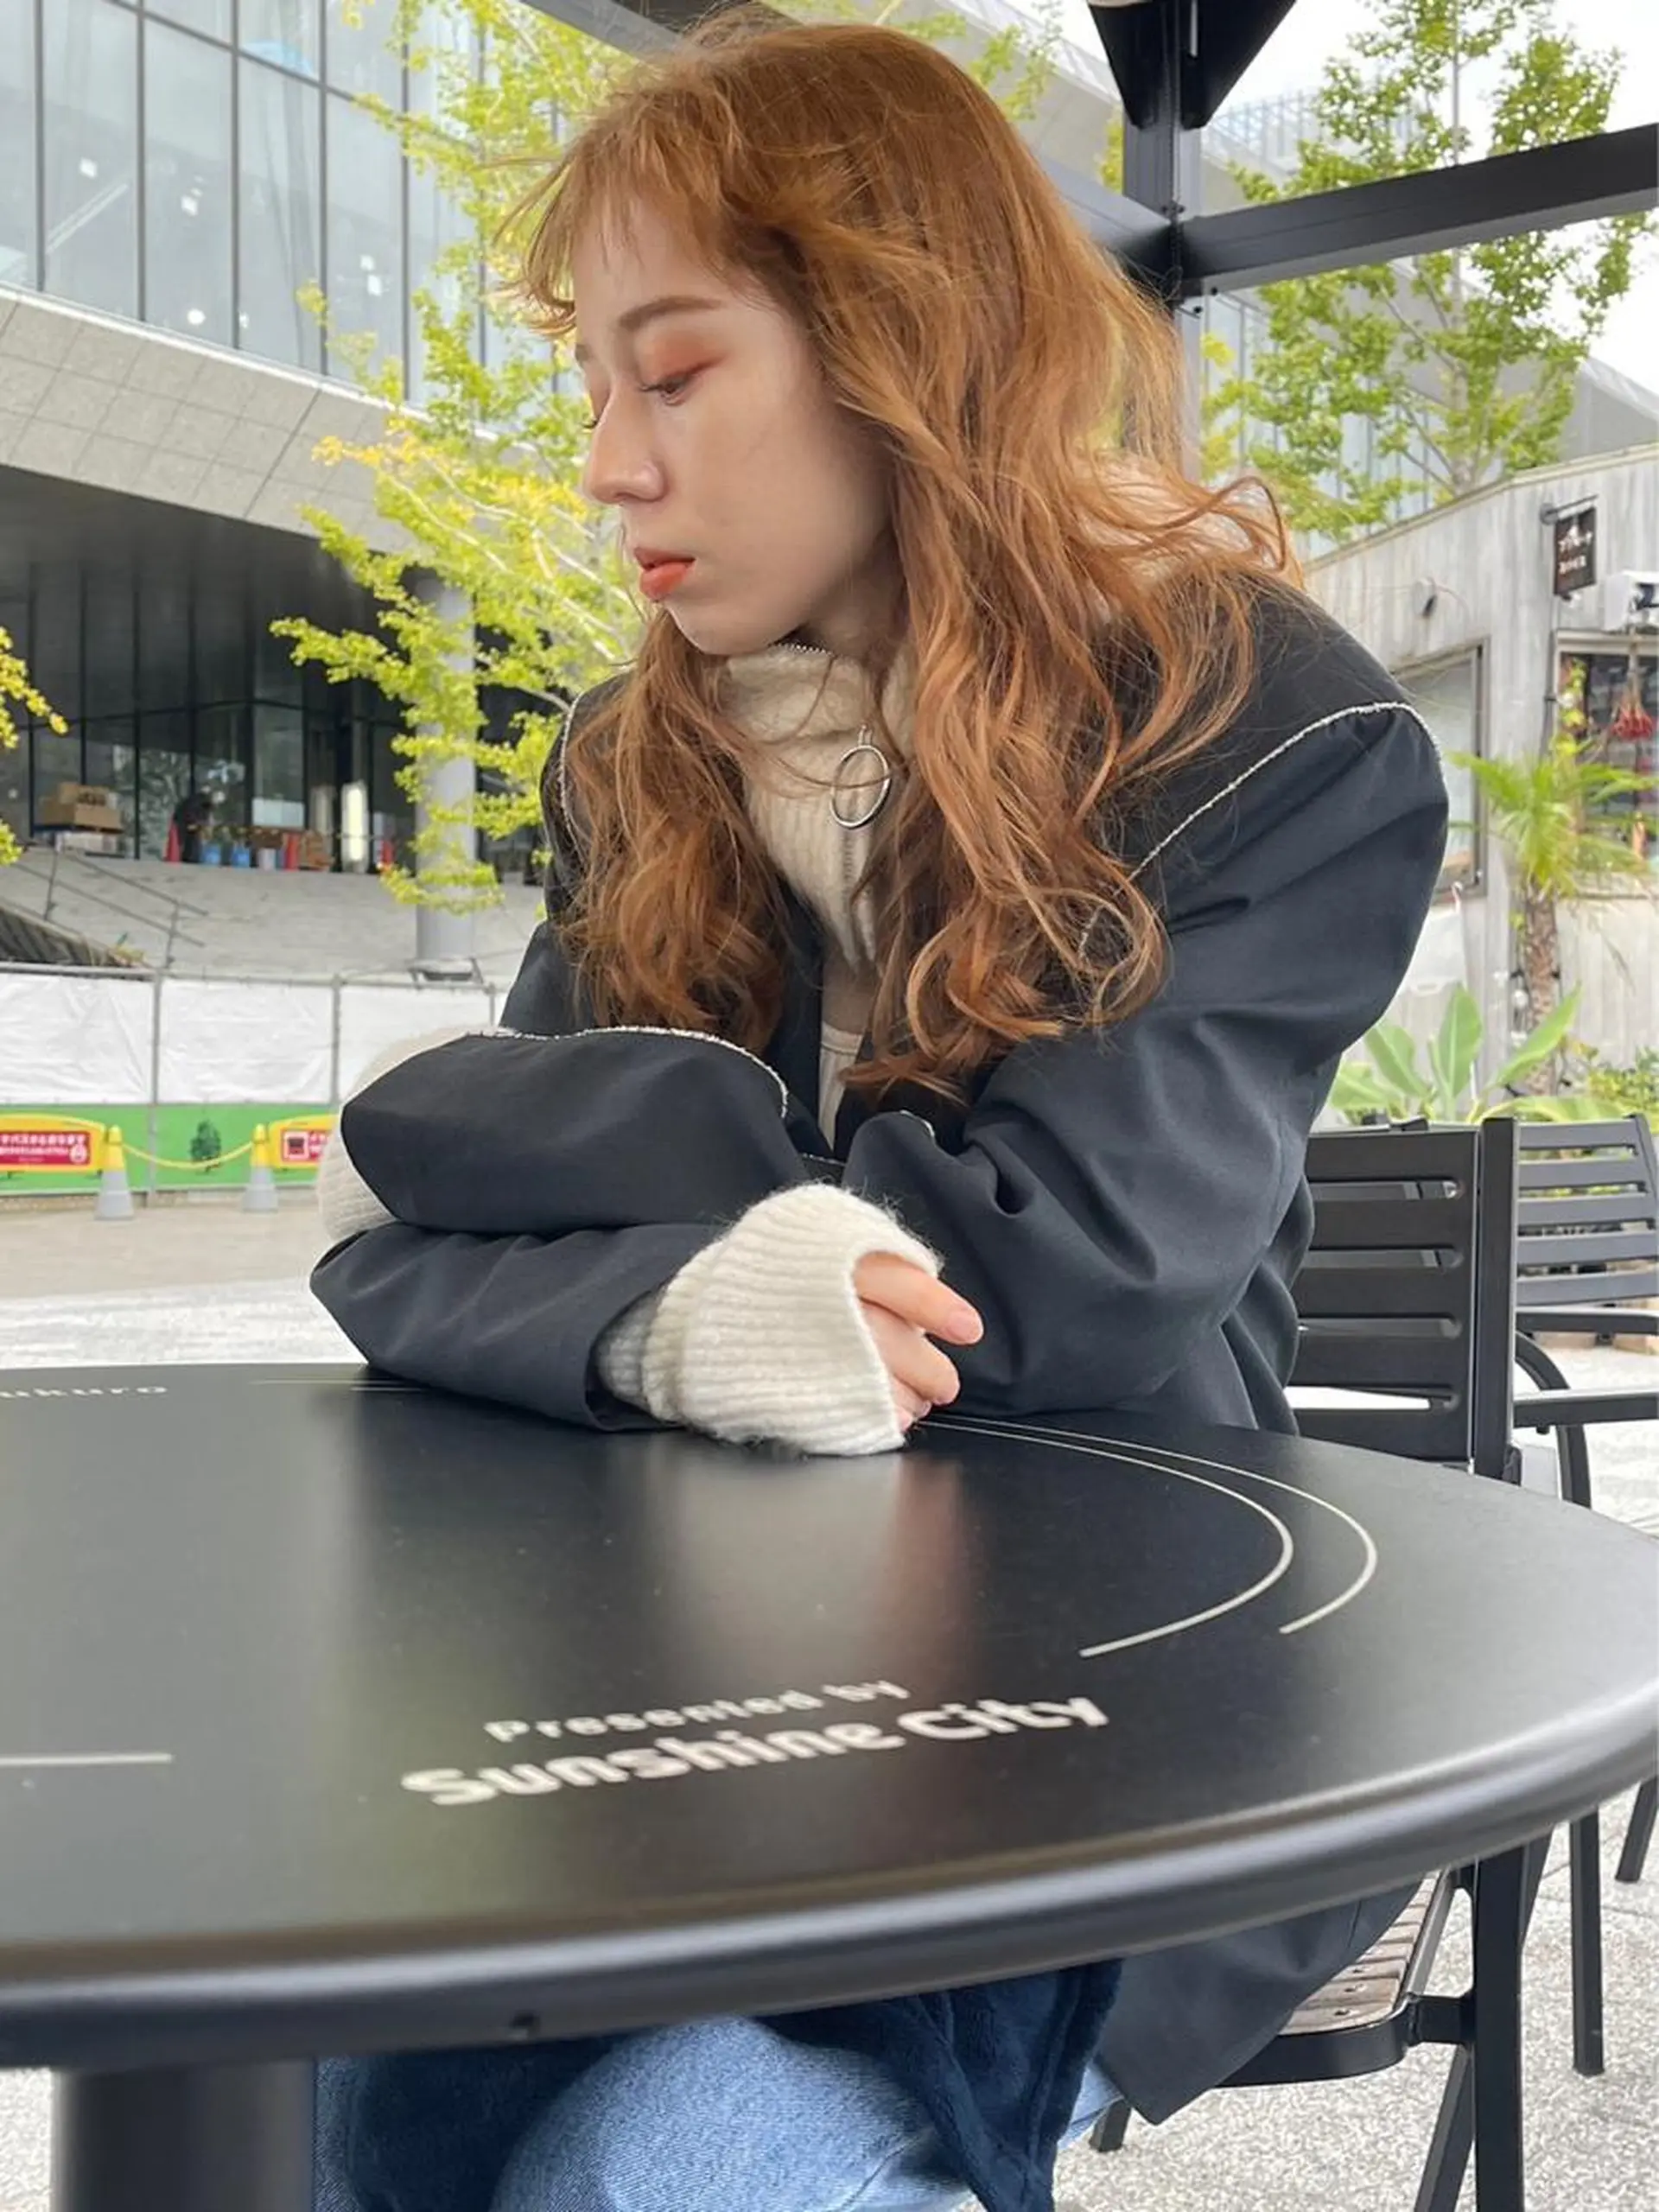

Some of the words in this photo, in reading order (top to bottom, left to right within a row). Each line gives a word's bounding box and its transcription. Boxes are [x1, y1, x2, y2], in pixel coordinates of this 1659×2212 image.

[400, 1721, 907, 1806] Sunshine
[897, 1696, 1109, 1740] City
[484, 1690, 825, 1742] Presented
[823, 1679, 912, 1700] by
